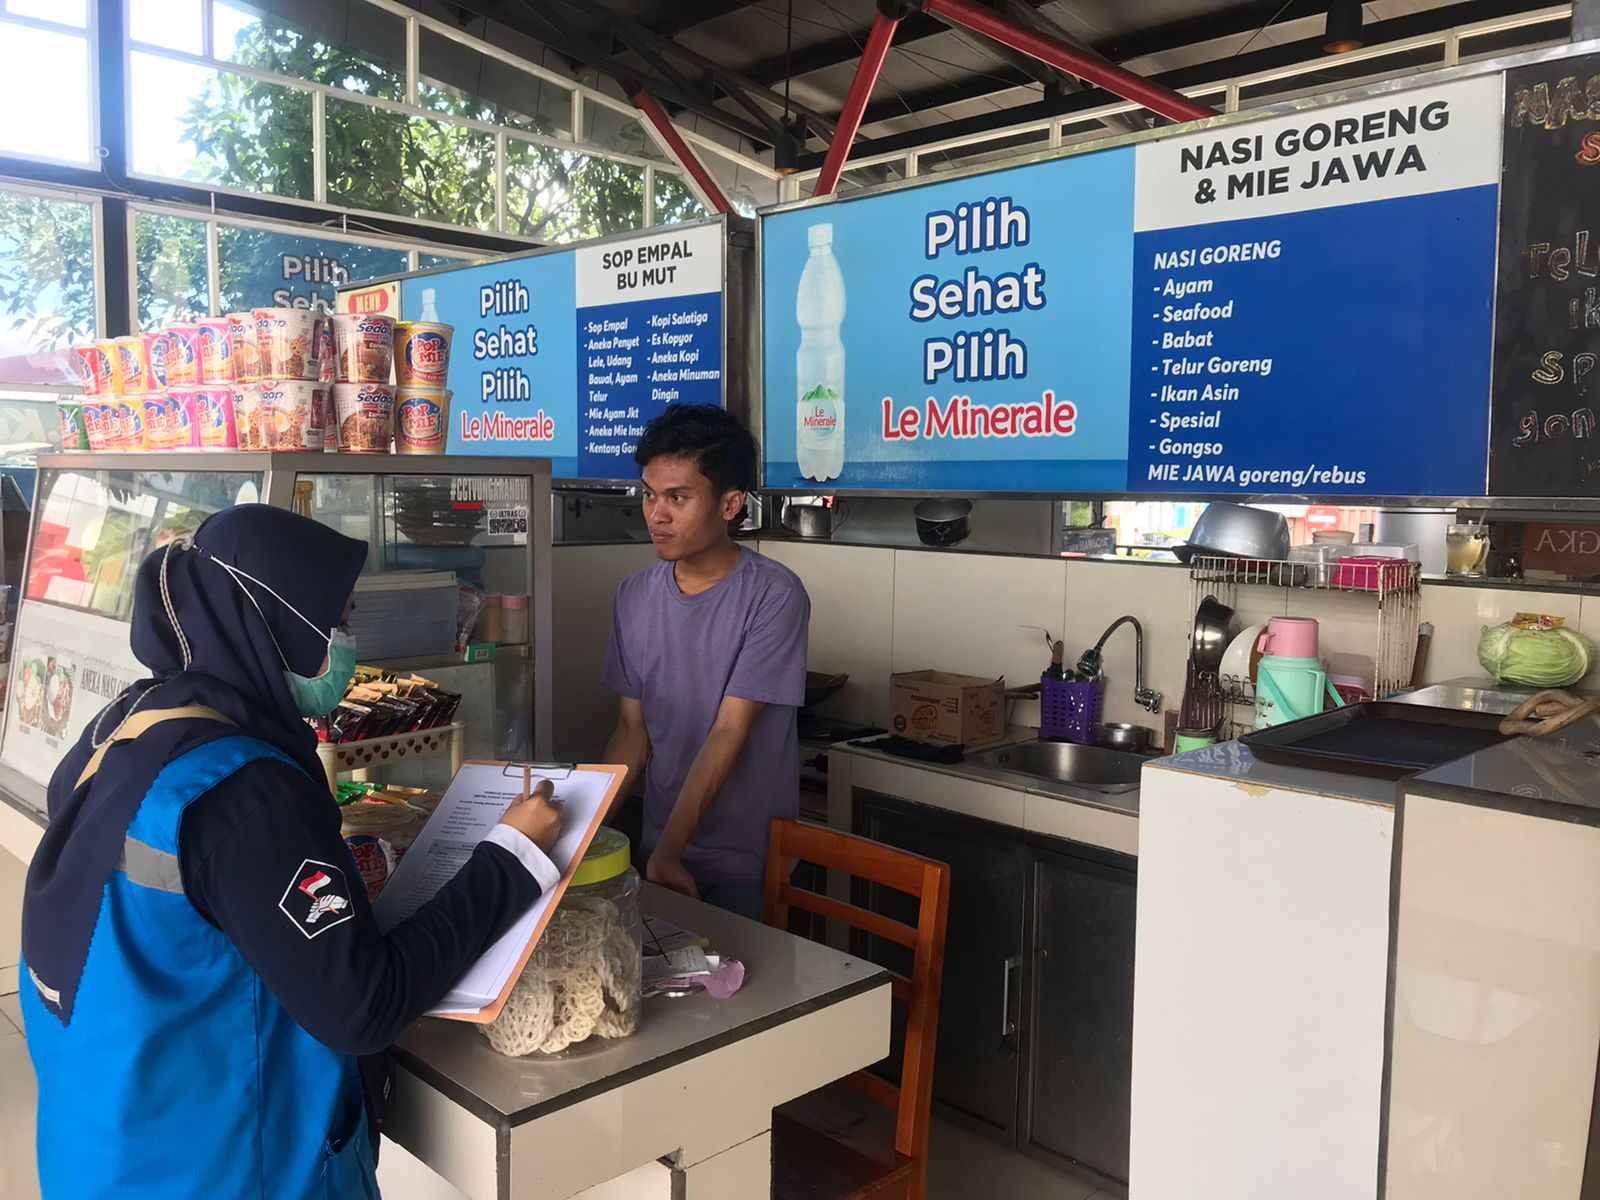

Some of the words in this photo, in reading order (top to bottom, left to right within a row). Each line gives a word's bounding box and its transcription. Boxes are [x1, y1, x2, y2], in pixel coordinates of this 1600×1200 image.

[1180, 135, 1263, 173] NASI
[1275, 100, 1450, 157] GORENG
[1194, 178, 1217, 204] &
[1227, 166, 1290, 200] MIE
[1299, 144, 1427, 190] JAWA
[924, 196, 1029, 258] Pilih
[602, 251, 633, 270] SOP
[637, 240, 693, 265] EMPAL
[1154, 249, 1196, 270] NASI
[1200, 240, 1281, 264] GORENG
[282, 255, 350, 284] Pilih
[616, 272, 638, 290] BU
[642, 266, 677, 287] MUT
[911, 265, 1044, 320] Sehat
[1163, 279, 1213, 298] Ayam
[356, 293, 381, 313] MENU
[480, 282, 530, 316] Pilih
[652, 314, 670, 328] Kopi
[672, 311, 708, 326] Salatiga
[1163, 300, 1233, 322] Seafood
[588, 322, 602, 334] Sop
[604, 318, 628, 333] Empal
[413, 339, 441, 352] POP
[474, 327, 536, 358] Sehat
[588, 338, 612, 350] Aneka
[613, 336, 639, 350] Penyet
[652, 334, 661, 345] Es
[662, 333, 693, 346] Kopyor
[1163, 331, 1213, 348] Babat
[418, 351, 445, 363] MIE
[589, 356, 605, 368] Lele,
[607, 355, 631, 368] Udang
[652, 351, 677, 363] Aneka
[679, 349, 699, 364] Kopi
[922, 327, 1028, 383] Pilih
[1163, 358, 1204, 375] Telur
[1208, 357, 1272, 375] Goreng
[589, 373, 613, 385] Bawal,
[615, 372, 638, 386] Ayam
[652, 370, 678, 382] Aneka
[679, 369, 720, 380] Minuman
[481, 371, 530, 400] Pilih
[1161, 385, 1197, 401] Ikan
[1201, 384, 1238, 400] Asin
[589, 391, 607, 402] Telur
[652, 388, 679, 402] Dingin
[404, 404, 430, 418] POP
[589, 408, 602, 419] Mie
[603, 408, 625, 421] Ayam
[627, 407, 639, 418] Jkt
[815, 406, 825, 417] Le
[883, 399, 918, 438] Le
[924, 392, 1076, 437] Minerale
[408, 418, 436, 429] MIE
[461, 412, 480, 439] Le
[483, 411, 553, 438] Minerale
[804, 416, 837, 427] Minerale
[1160, 411, 1220, 432] Spesial
[588, 426, 612, 437] Aneka
[613, 425, 628, 437] Mie
[589, 442, 620, 456] Kentang
[1160, 438, 1222, 458] Gongso
[1148, 465, 1180, 480] MIE
[1183, 465, 1235, 482] JAWA
[1239, 465, 1366, 487] goreng/rebus
